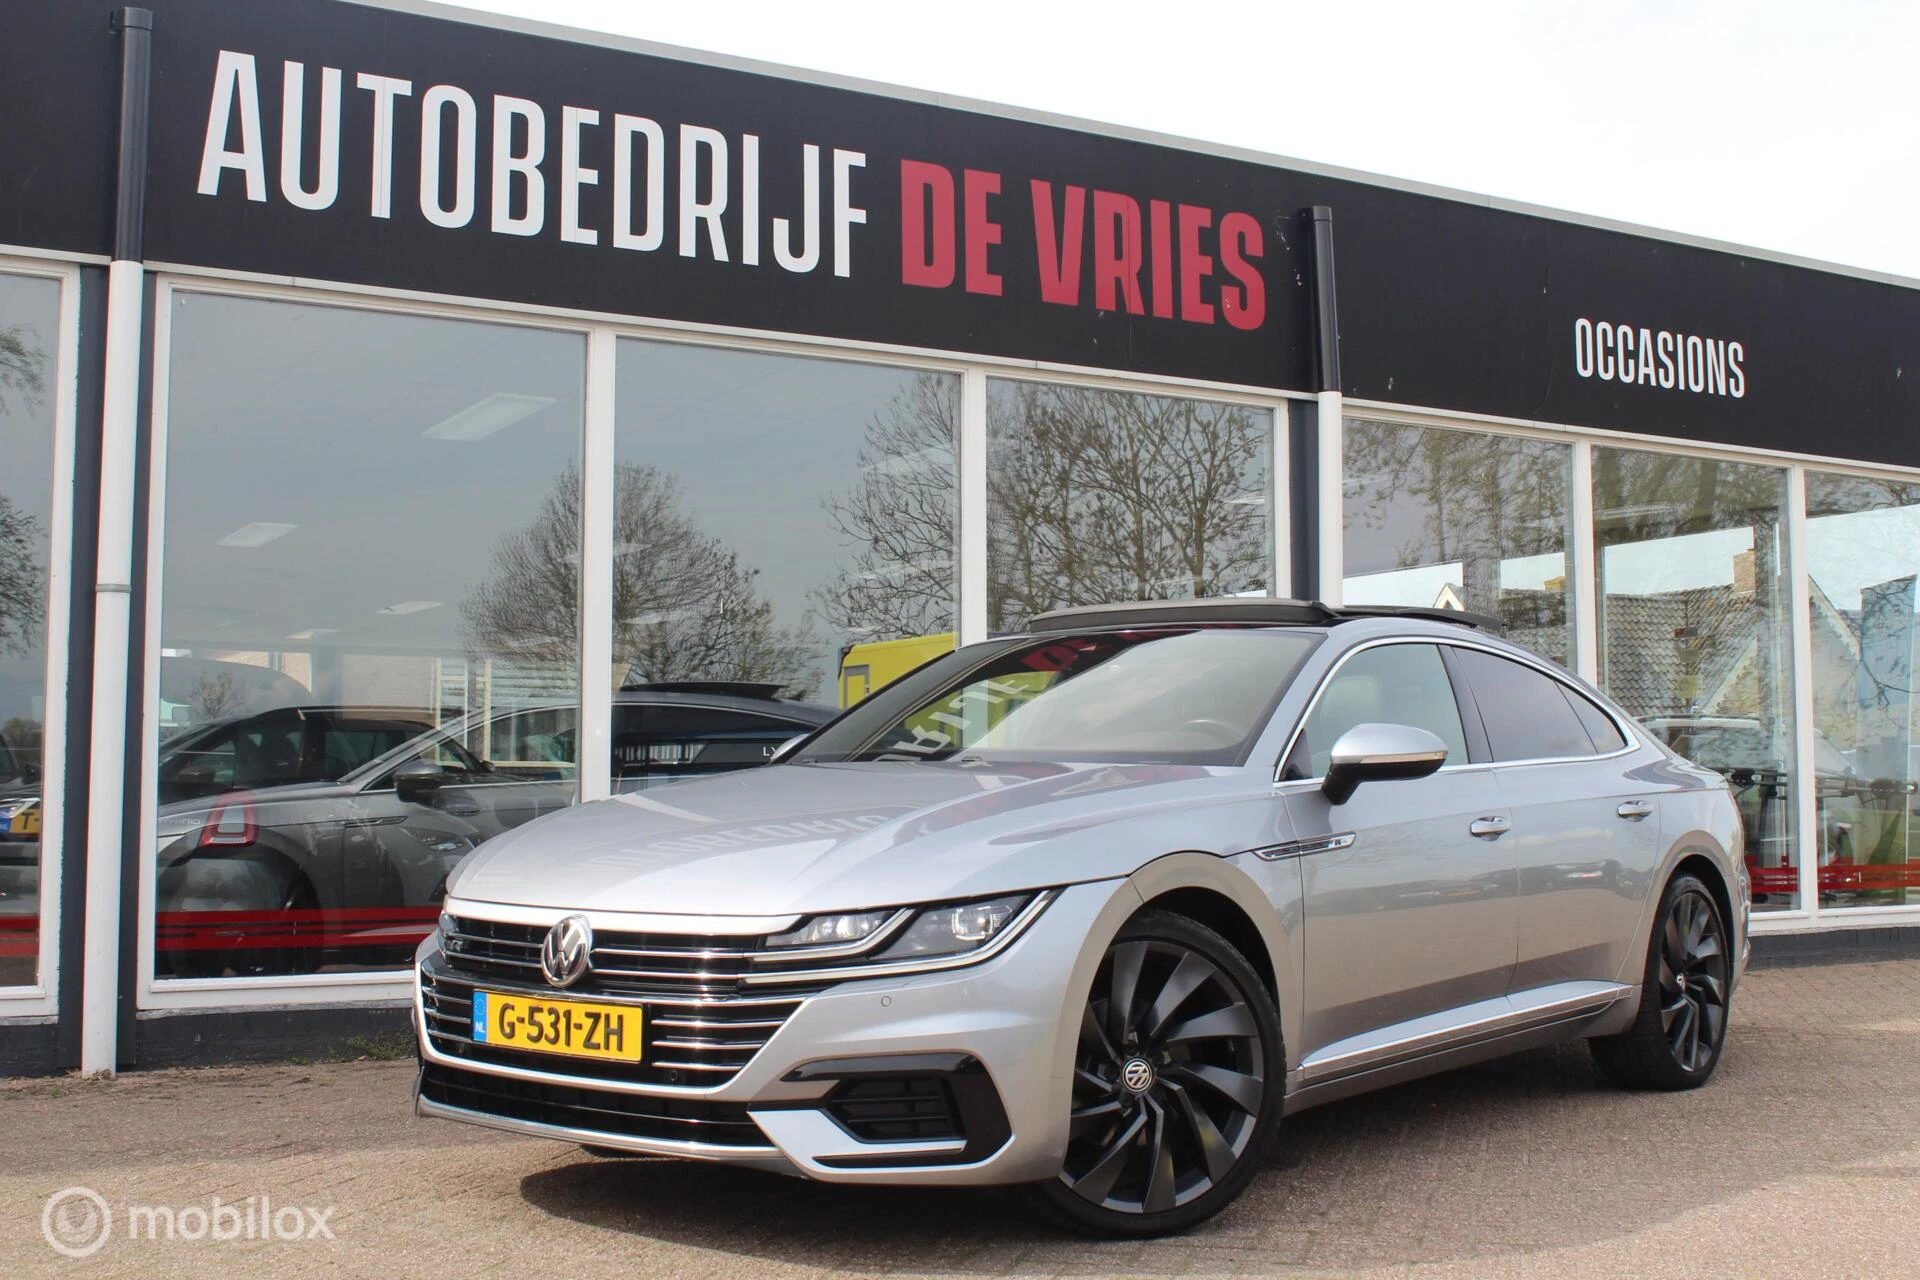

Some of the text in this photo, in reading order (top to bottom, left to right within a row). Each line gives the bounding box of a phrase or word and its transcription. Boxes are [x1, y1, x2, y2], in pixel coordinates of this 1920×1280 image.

[197, 49, 1266, 331] AUTOBEDRIJF DE VRIES
[1574, 317, 1745, 399] OCCASIONS
[499, 1002, 624, 1052] G-531-ZH
